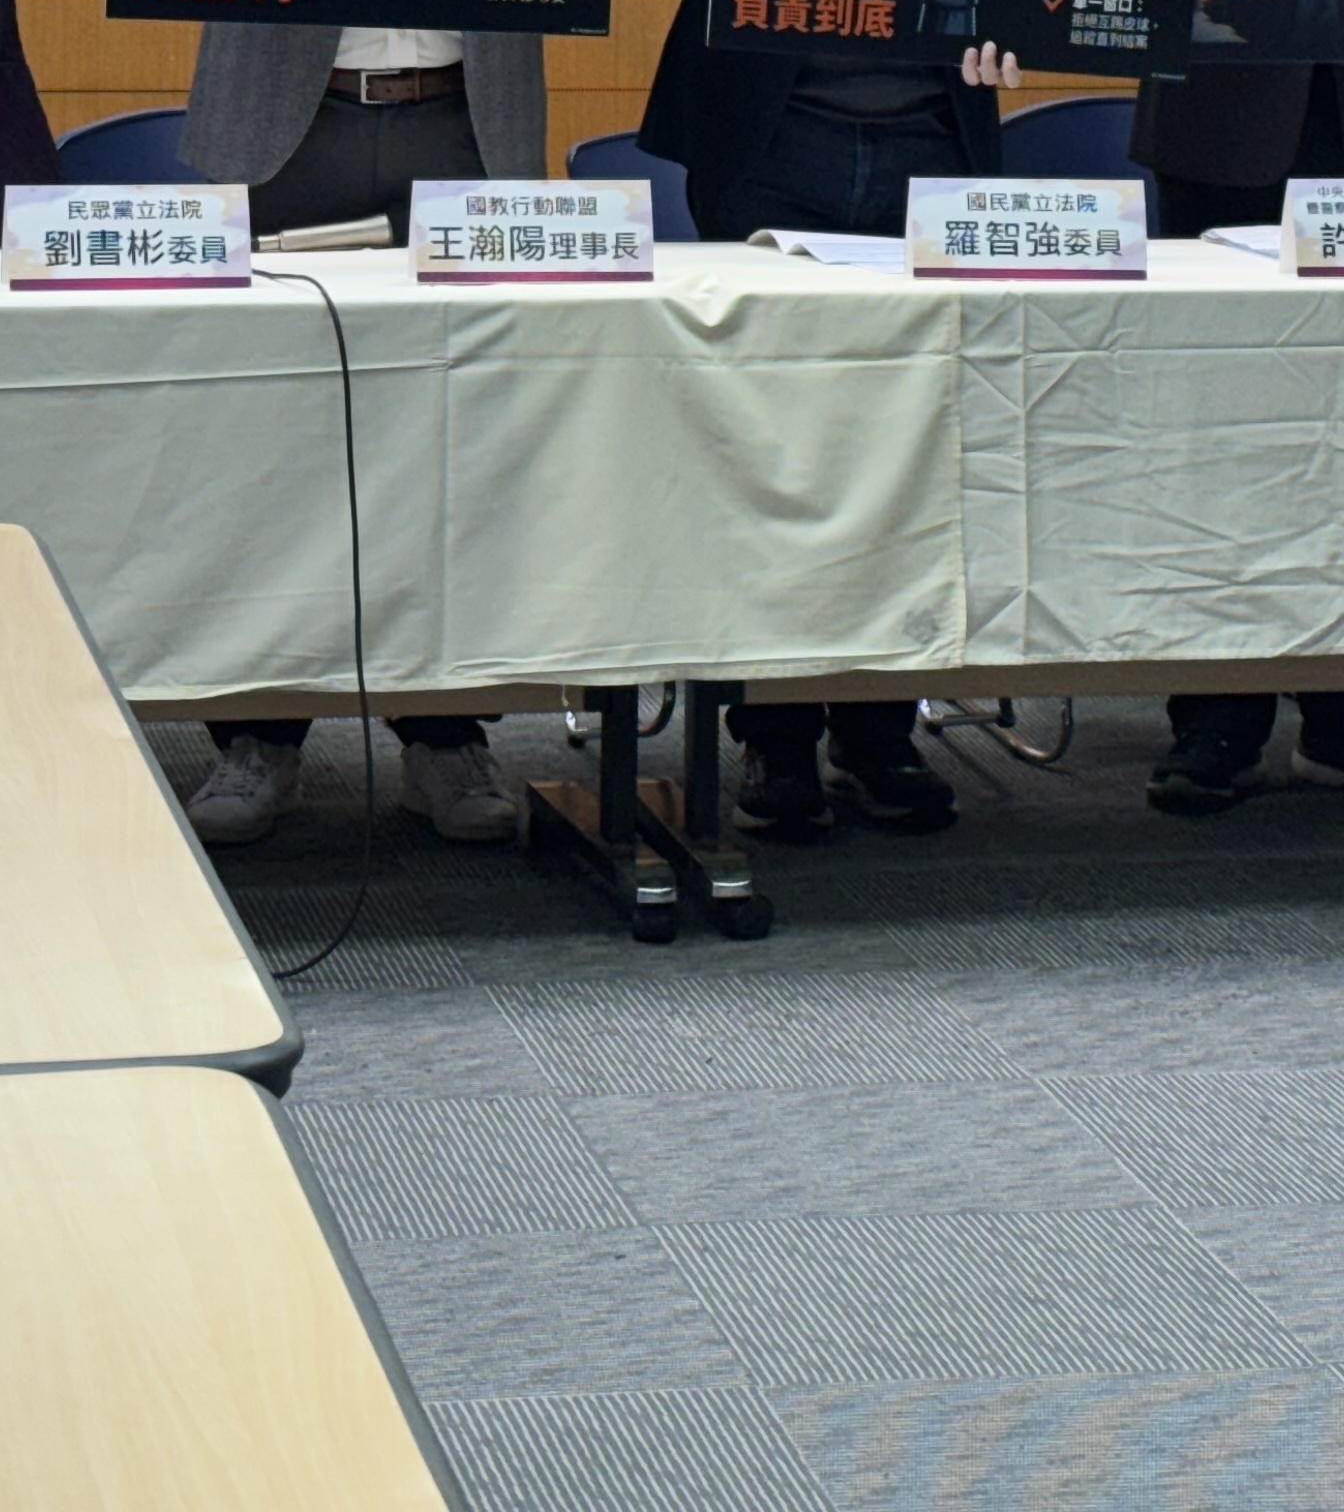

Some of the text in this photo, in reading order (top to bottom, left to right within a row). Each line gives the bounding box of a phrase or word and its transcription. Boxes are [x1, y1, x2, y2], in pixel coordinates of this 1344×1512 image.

[68, 200, 203, 220] 民眾黨立法院
[466, 196, 598, 216] 國教行動聯盟
[967, 192, 1098, 213] 國民黨立法院
[44, 229, 228, 266] 劉書彬委員
[429, 225, 639, 262] 王瀚陽理事長
[945, 220, 1123, 257] 羅智強委員
